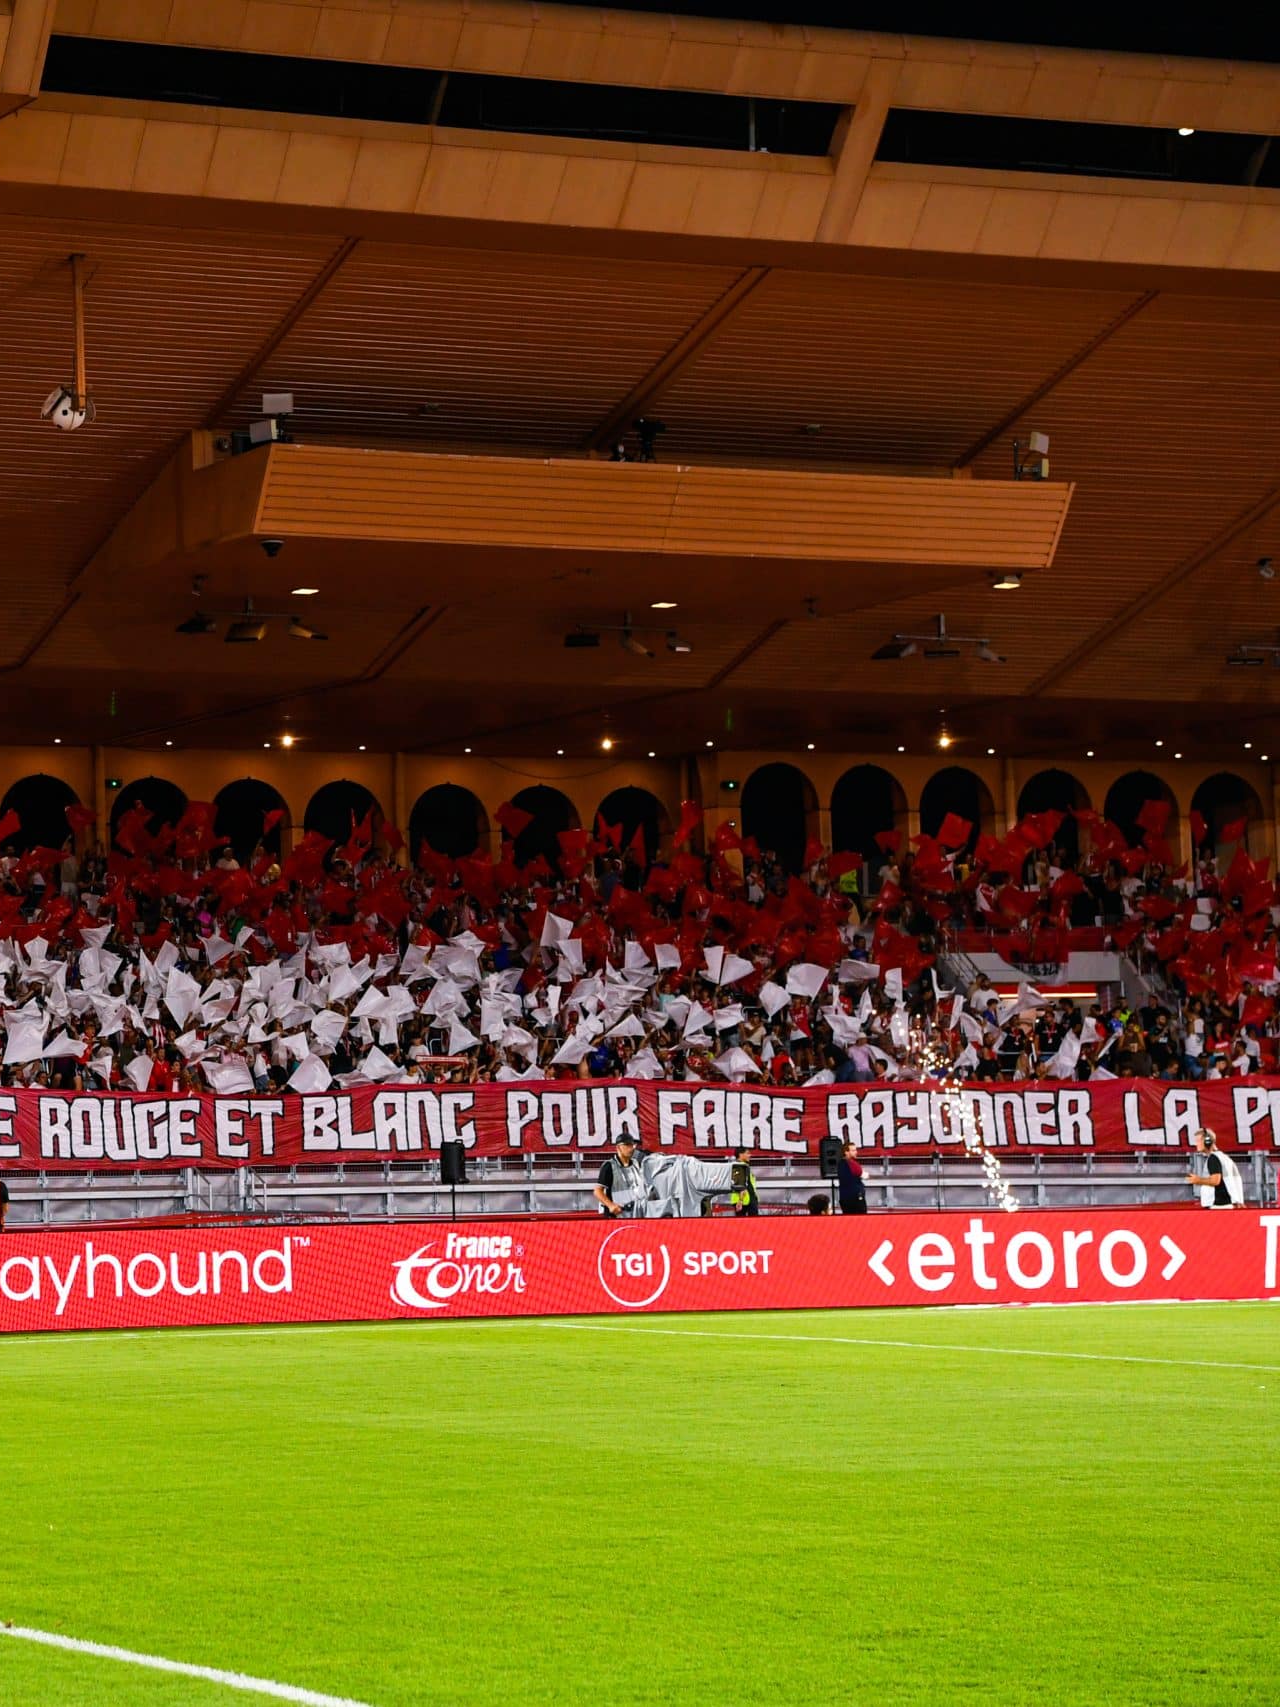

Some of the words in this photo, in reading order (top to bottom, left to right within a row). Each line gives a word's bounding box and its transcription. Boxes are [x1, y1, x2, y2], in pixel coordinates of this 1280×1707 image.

[39, 1096, 202, 1161] ROUGE
[214, 1098, 284, 1158] ET
[302, 1090, 476, 1151] BLANC
[505, 1086, 641, 1148] POUR
[657, 1088, 808, 1154] FAIRE
[827, 1089, 1095, 1148] RAYONNER
[1123, 1087, 1201, 1147] LA
[445, 1232, 513, 1259] France
[610, 1253, 653, 1277] TGI
[683, 1250, 774, 1276] SPORT
